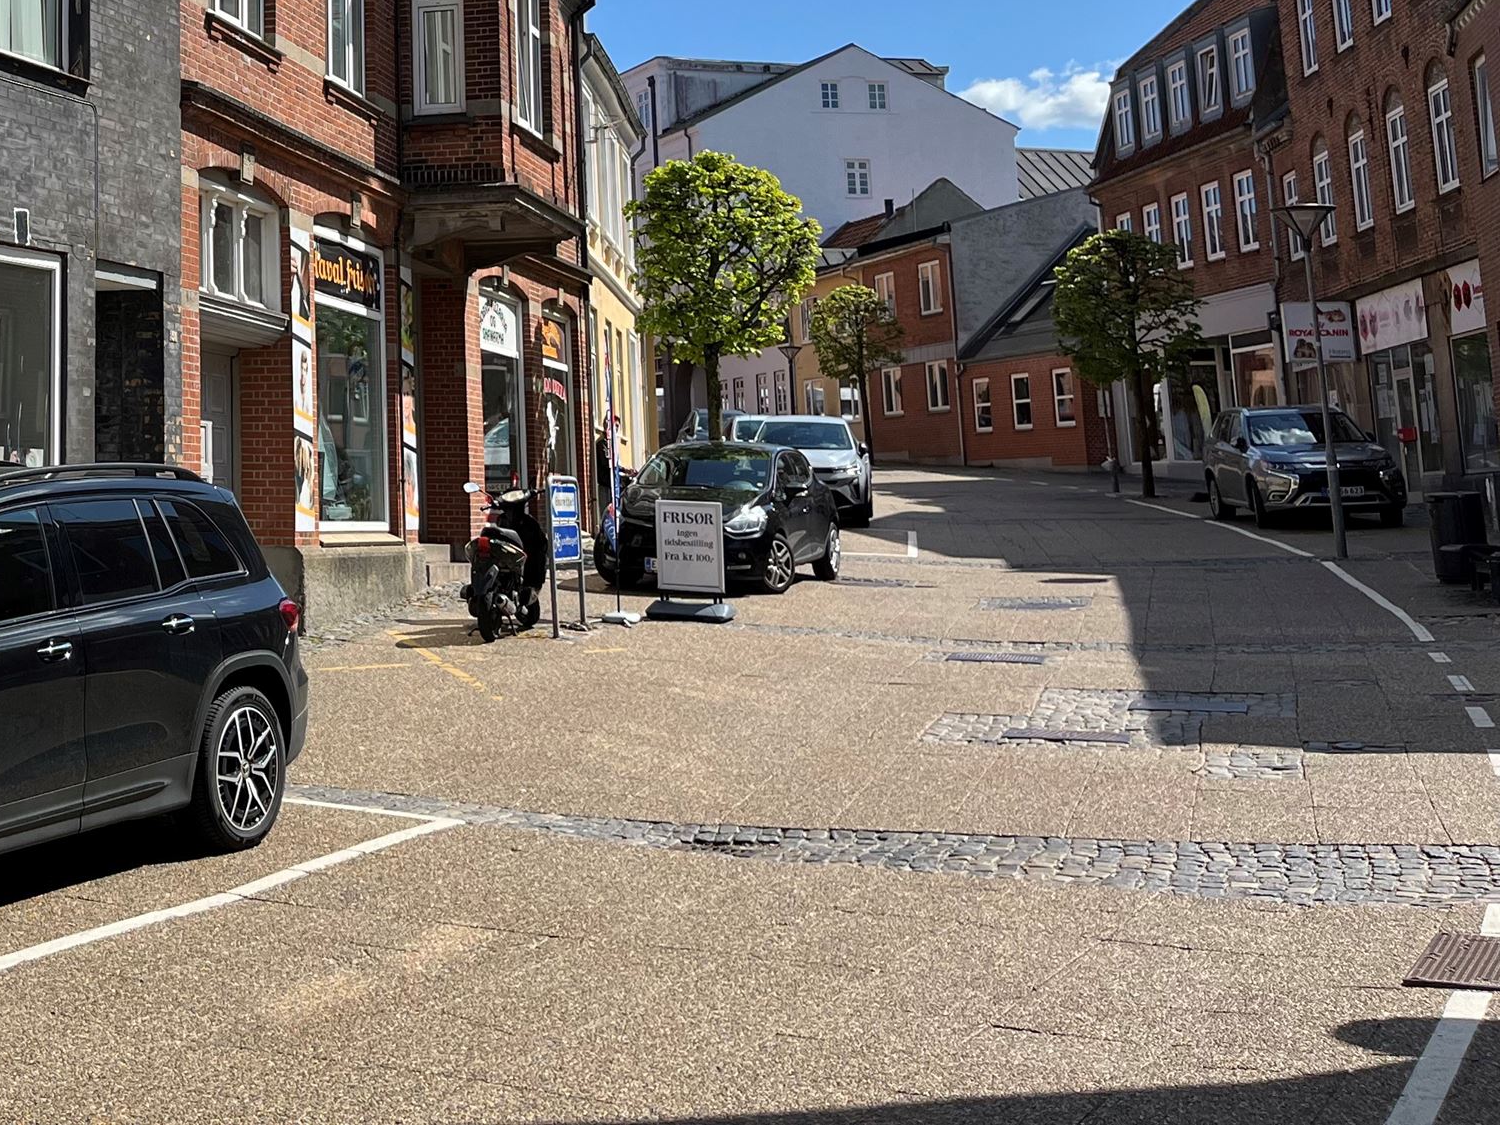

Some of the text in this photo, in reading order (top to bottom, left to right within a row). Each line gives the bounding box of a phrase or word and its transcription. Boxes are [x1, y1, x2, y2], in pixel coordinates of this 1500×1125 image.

[663, 511, 714, 525] FRISØR
[664, 538, 714, 549] tidsbestilling
[664, 551, 680, 561] Fra
